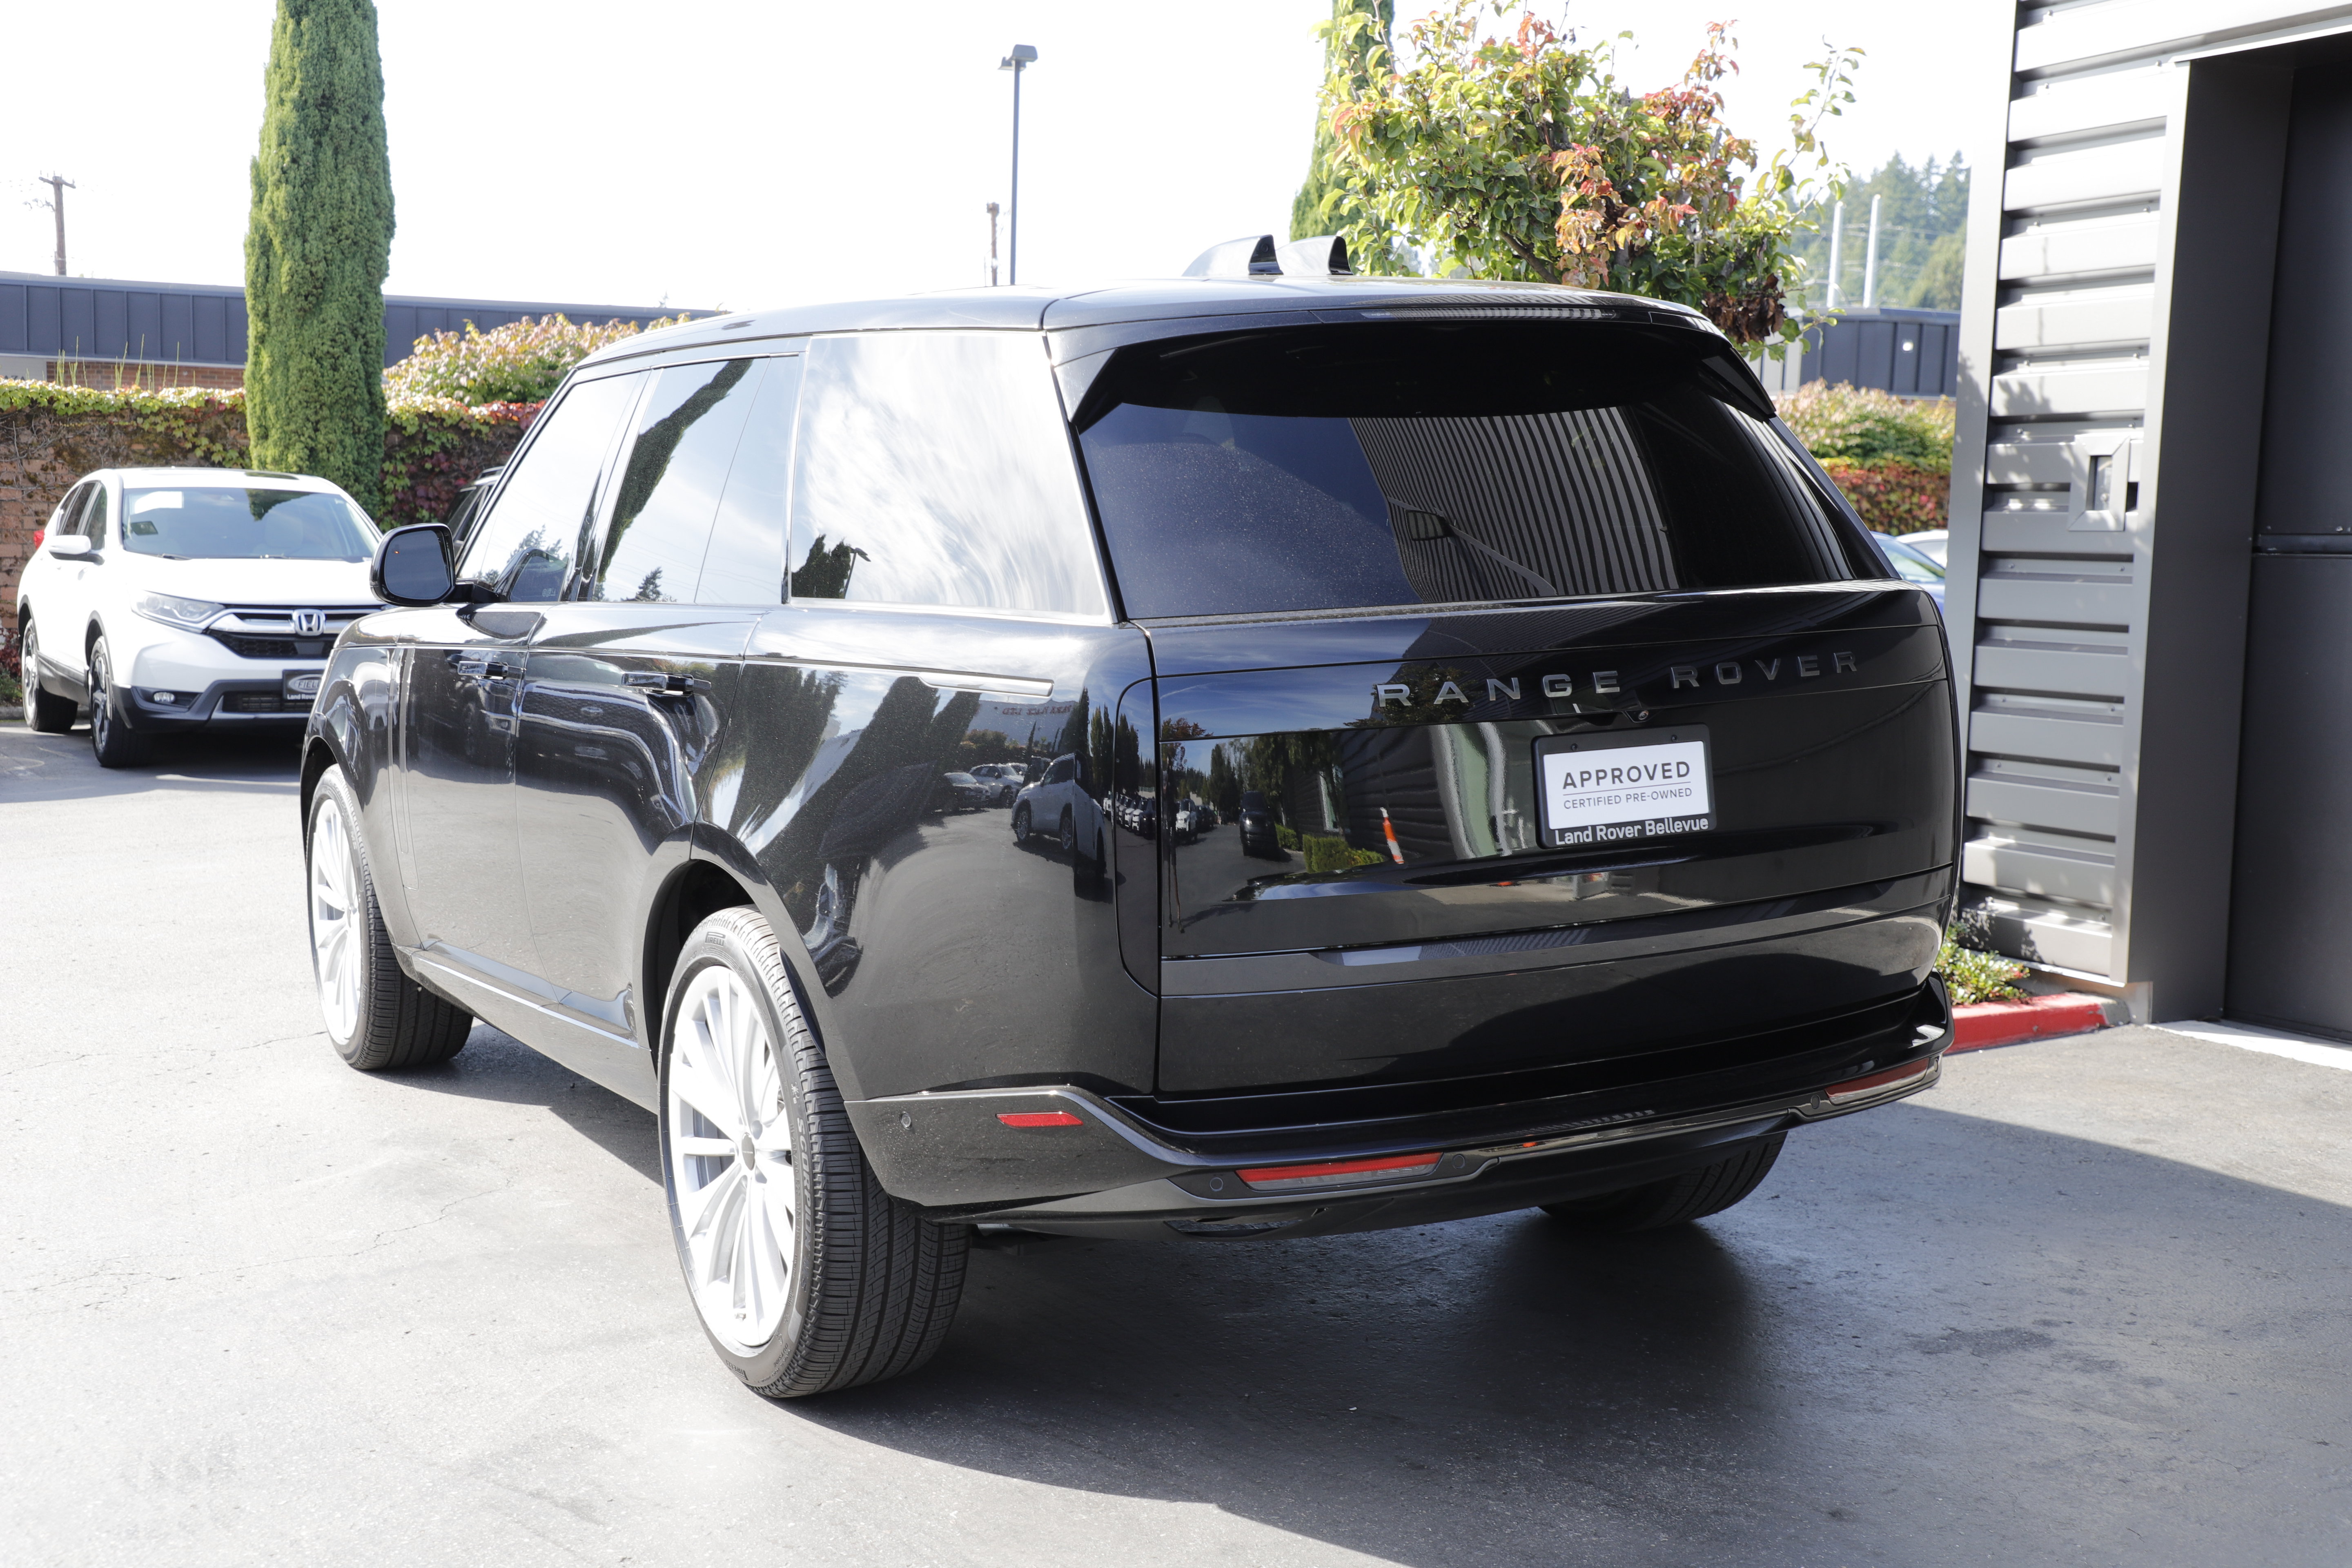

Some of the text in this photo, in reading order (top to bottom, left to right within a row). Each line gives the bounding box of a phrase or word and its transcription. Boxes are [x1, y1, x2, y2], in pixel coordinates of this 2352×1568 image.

[1376, 651, 1857, 707] RANGE ROVER
[1562, 761, 1690, 790] APPROVED
[1564, 788, 1692, 809] CERTIFIED PRE-OWNED
[1555, 817, 1708, 845] Land Rover Bellevue
[704, 931, 726, 947] PIRELLI
[797, 1117, 811, 1251] SCORPION
[725, 1359, 749, 1381] PIRELLI
